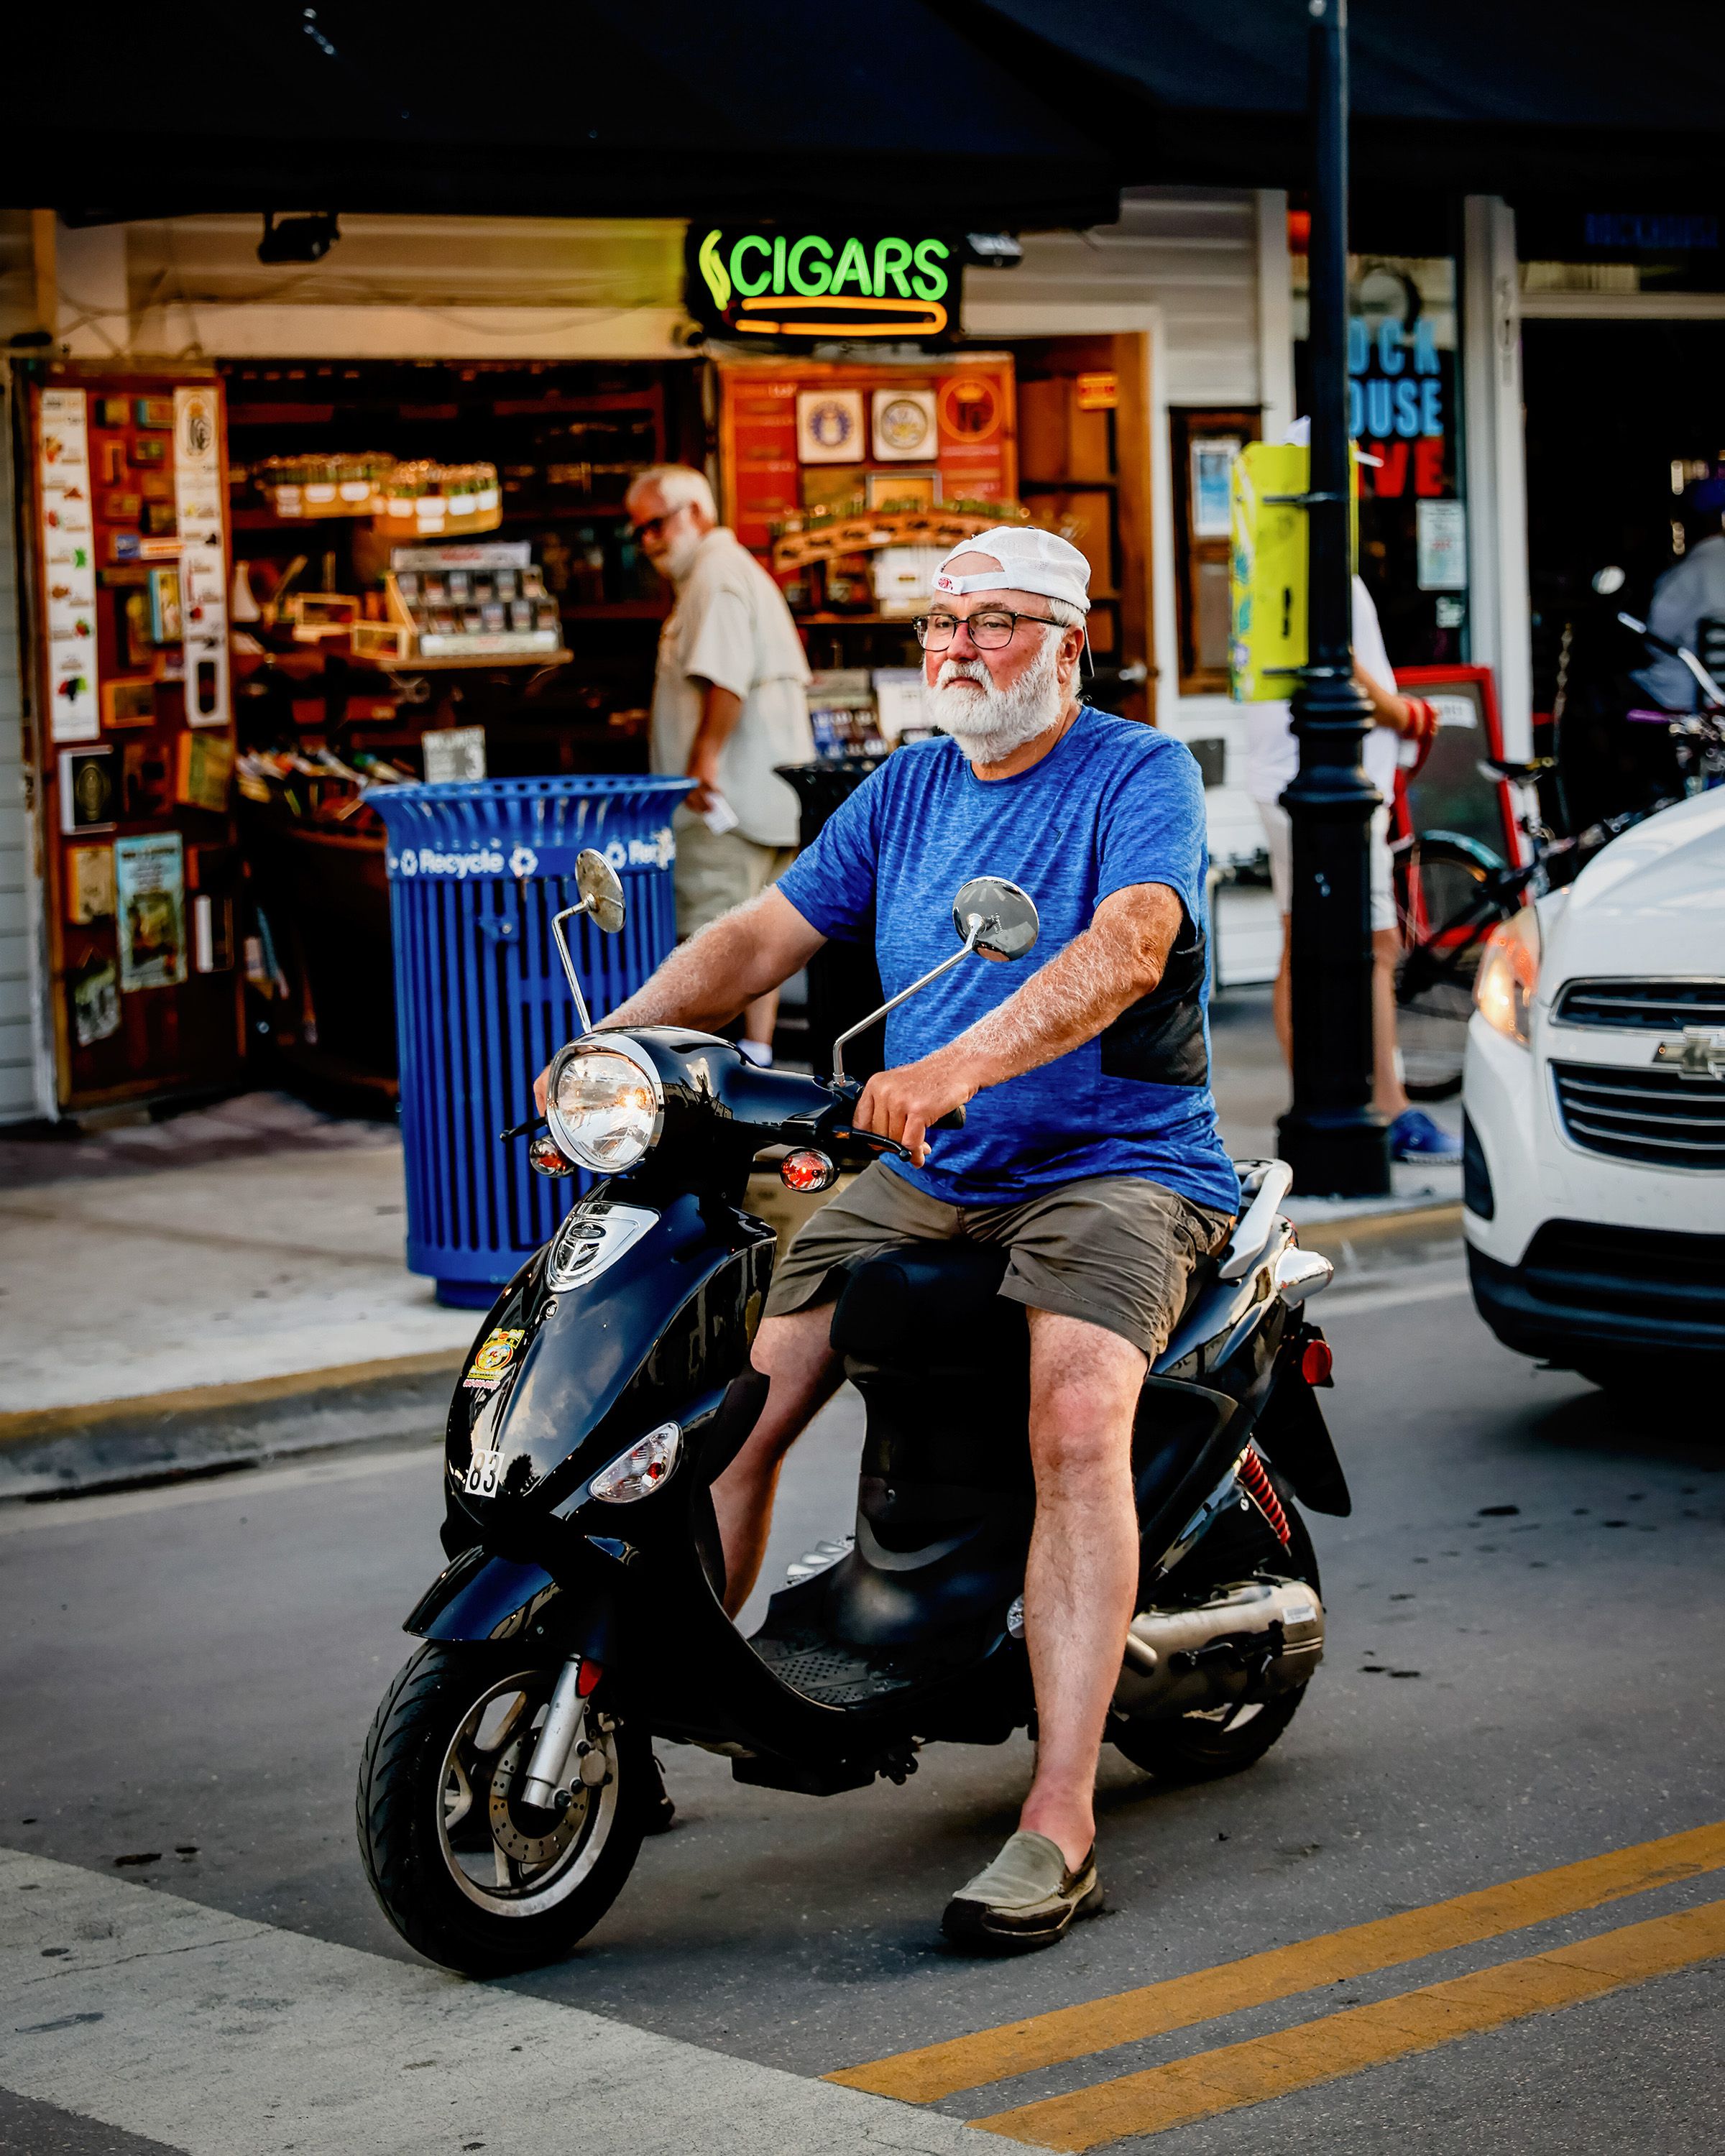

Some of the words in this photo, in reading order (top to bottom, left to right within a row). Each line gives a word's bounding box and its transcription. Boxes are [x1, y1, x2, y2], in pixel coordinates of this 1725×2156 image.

[730, 235, 949, 301] CIGARS
[1348, 316, 1441, 375] OCK
[1349, 378, 1443, 437] OUSE
[419, 847, 504, 879] Recycle
[470, 1452, 500, 1493] 83
